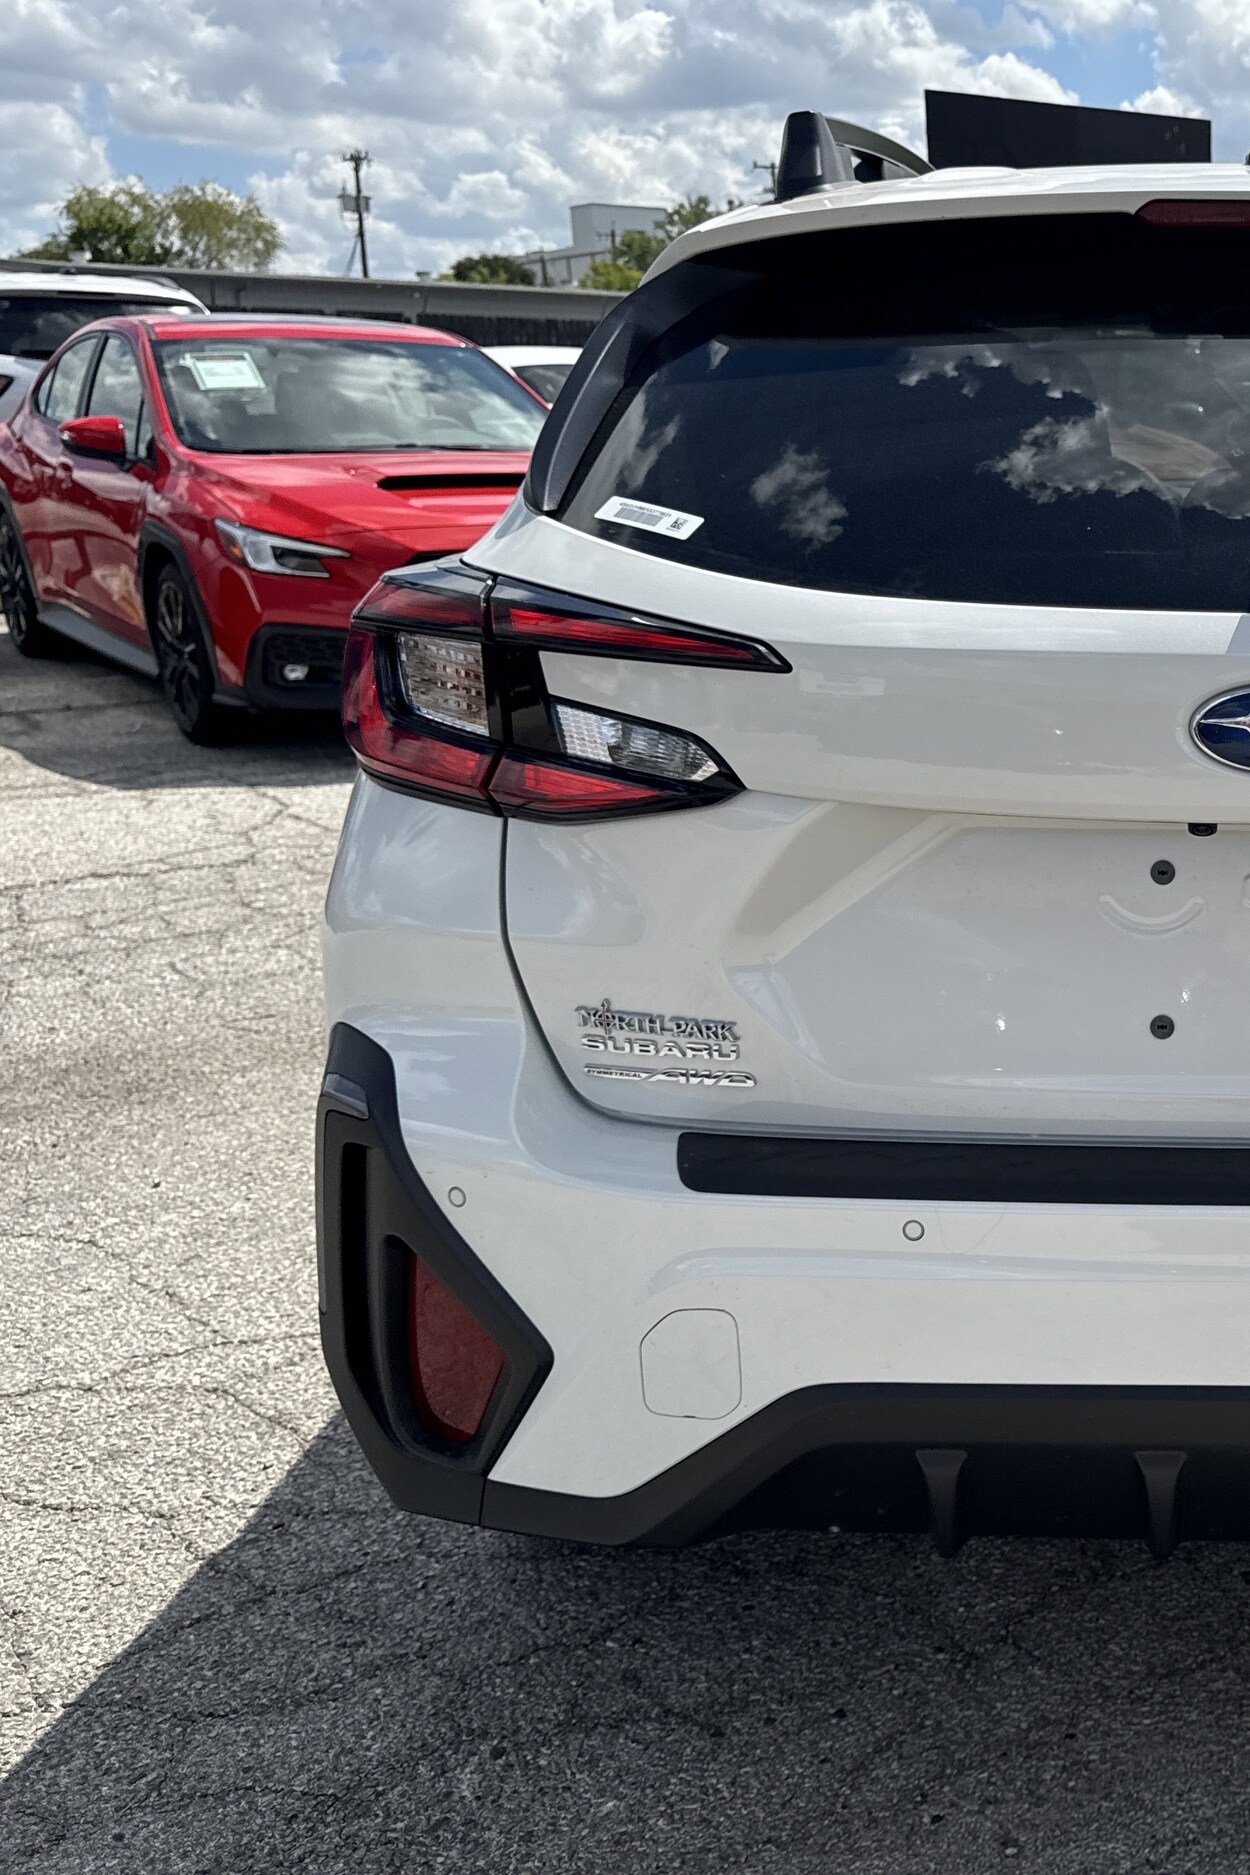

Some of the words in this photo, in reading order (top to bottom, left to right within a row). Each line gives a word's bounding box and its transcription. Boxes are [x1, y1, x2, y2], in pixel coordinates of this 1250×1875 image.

[577, 1006, 664, 1036] NORTH
[669, 1016, 741, 1043] PARK
[581, 1035, 739, 1061] SUBARU
[586, 1068, 643, 1079] SYMMETRICAL
[648, 1067, 757, 1088] AWD
